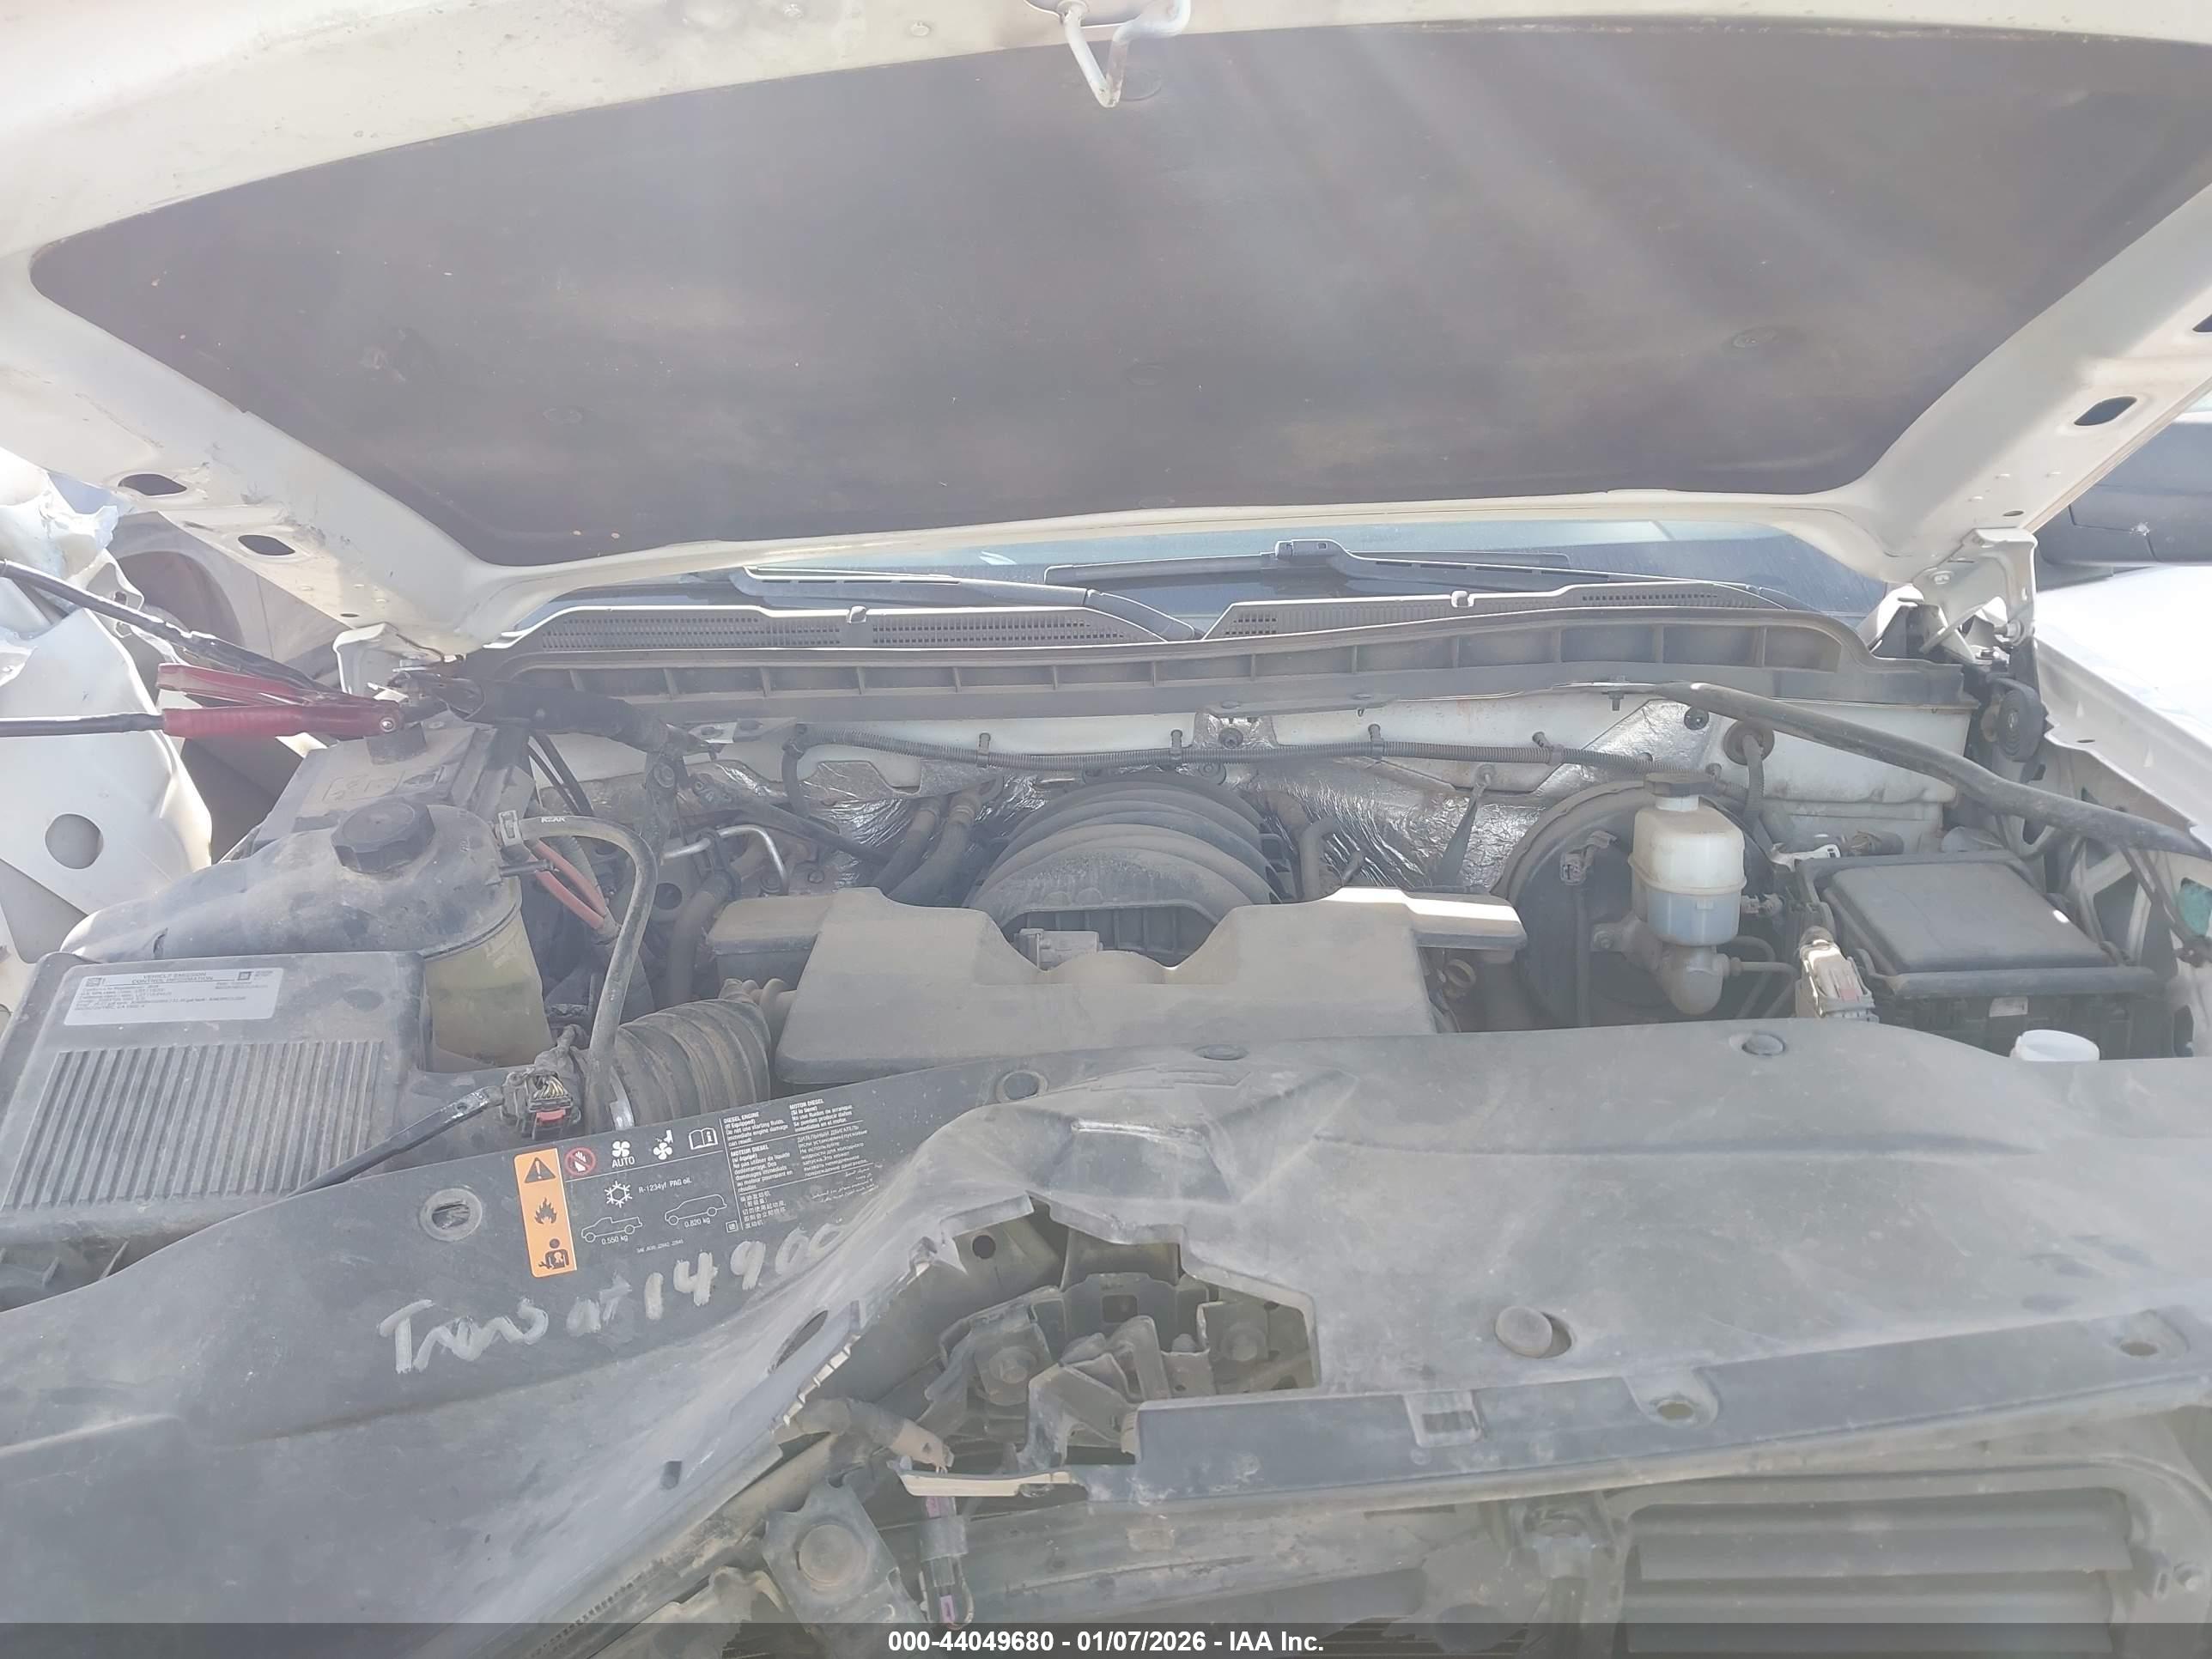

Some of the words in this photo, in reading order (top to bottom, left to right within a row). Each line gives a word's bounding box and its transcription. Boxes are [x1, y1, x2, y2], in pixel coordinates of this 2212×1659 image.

[611, 1156, 635, 1169] AUTO
[669, 1178, 682, 1188] PAG
[684, 1218, 702, 1228] 0.820
[601, 1236, 619, 1245] 0.550
[620, 1234, 629, 1243] kg
